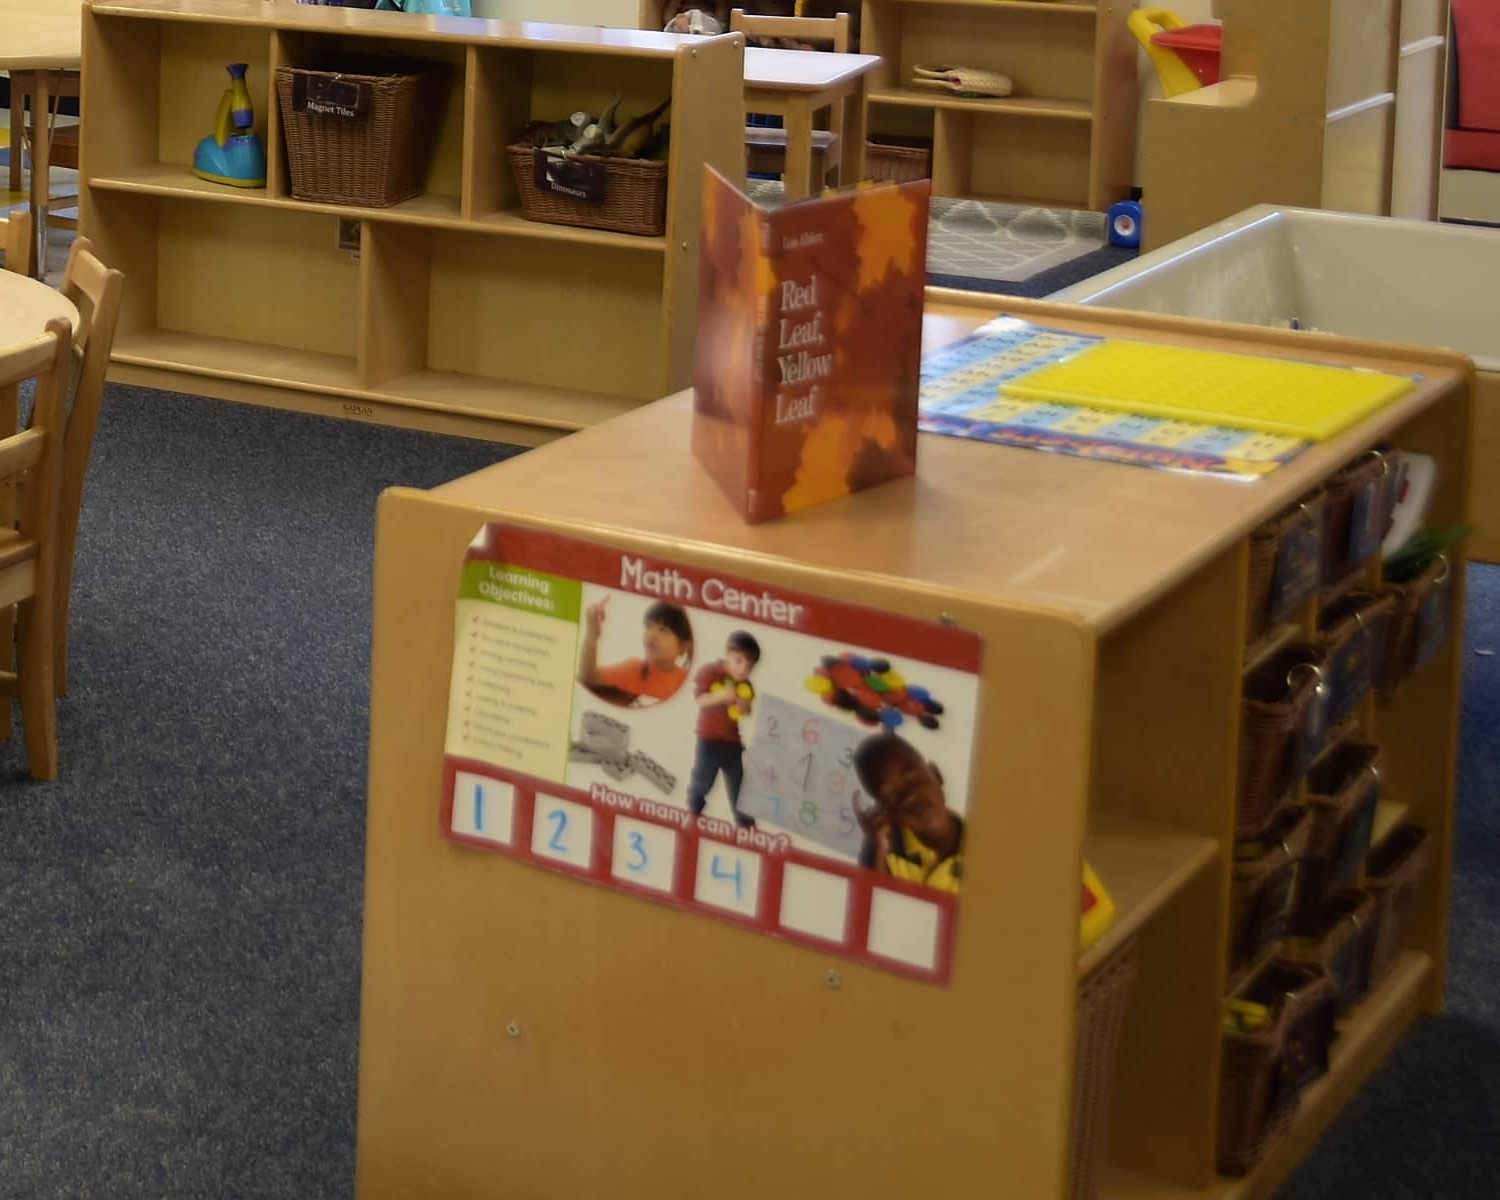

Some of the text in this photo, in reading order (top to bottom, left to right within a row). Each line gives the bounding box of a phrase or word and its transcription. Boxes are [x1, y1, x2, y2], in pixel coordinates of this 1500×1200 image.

[307, 101, 355, 117] Magnet Tiles
[550, 182, 587, 199] Dinosaurs
[780, 273, 818, 311] Red
[779, 311, 825, 349] Leaf,
[777, 350, 833, 387] Yellow
[775, 384, 820, 425] Leaf
[479, 580, 555, 611] Objectives:
[489, 565, 551, 595] Learning
[620, 555, 805, 625] Math Center
[473, 783, 485, 832] 1
[591, 783, 792, 853] How many can play?
[548, 809, 569, 852] 2
[627, 830, 648, 872] 3
[709, 854, 743, 900] 4
